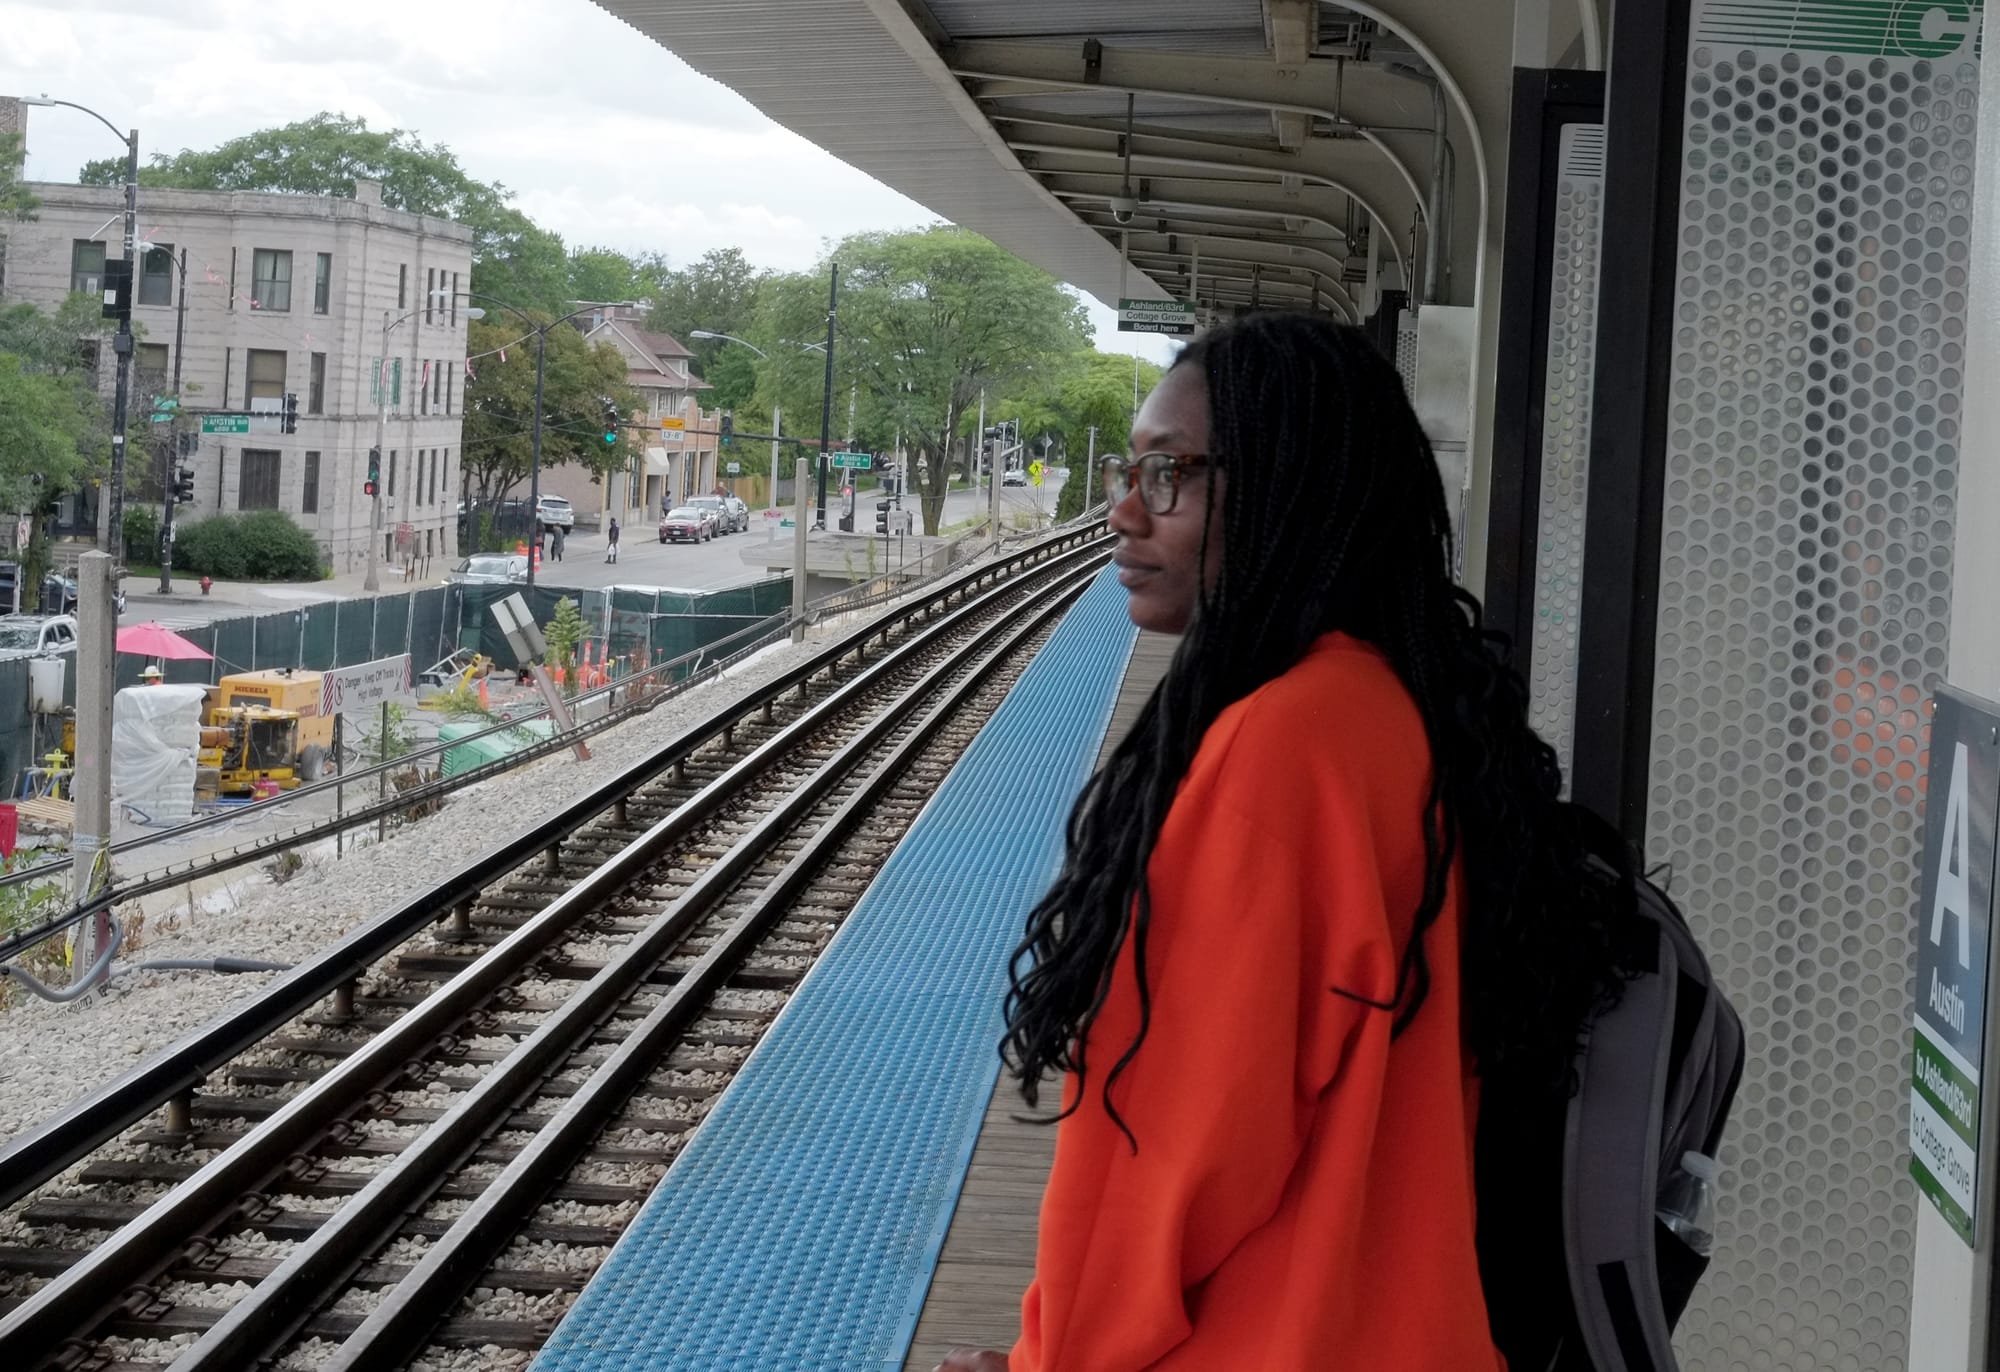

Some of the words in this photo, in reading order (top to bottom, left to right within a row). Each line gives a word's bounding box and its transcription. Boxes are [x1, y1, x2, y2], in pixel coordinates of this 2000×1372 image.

[1128, 301, 1185, 312] Ashland/63rd
[1126, 311, 1159, 321] Cottage
[1161, 312, 1186, 322] Grove
[1133, 323, 1159, 331] Board
[1160, 324, 1179, 333] here
[209, 417, 236, 426] AUSTIN
[344, 677, 361, 690] Danger
[1930, 741, 1969, 970] A
[1929, 966, 1965, 1035] Austin
[1916, 1048, 1924, 1080] to
[1924, 1056, 1972, 1129] Ashland/63rd
[1913, 1111, 1920, 1138] to
[1920, 1116, 1946, 1171] Cottage
[1947, 1146, 1970, 1195] Grove
